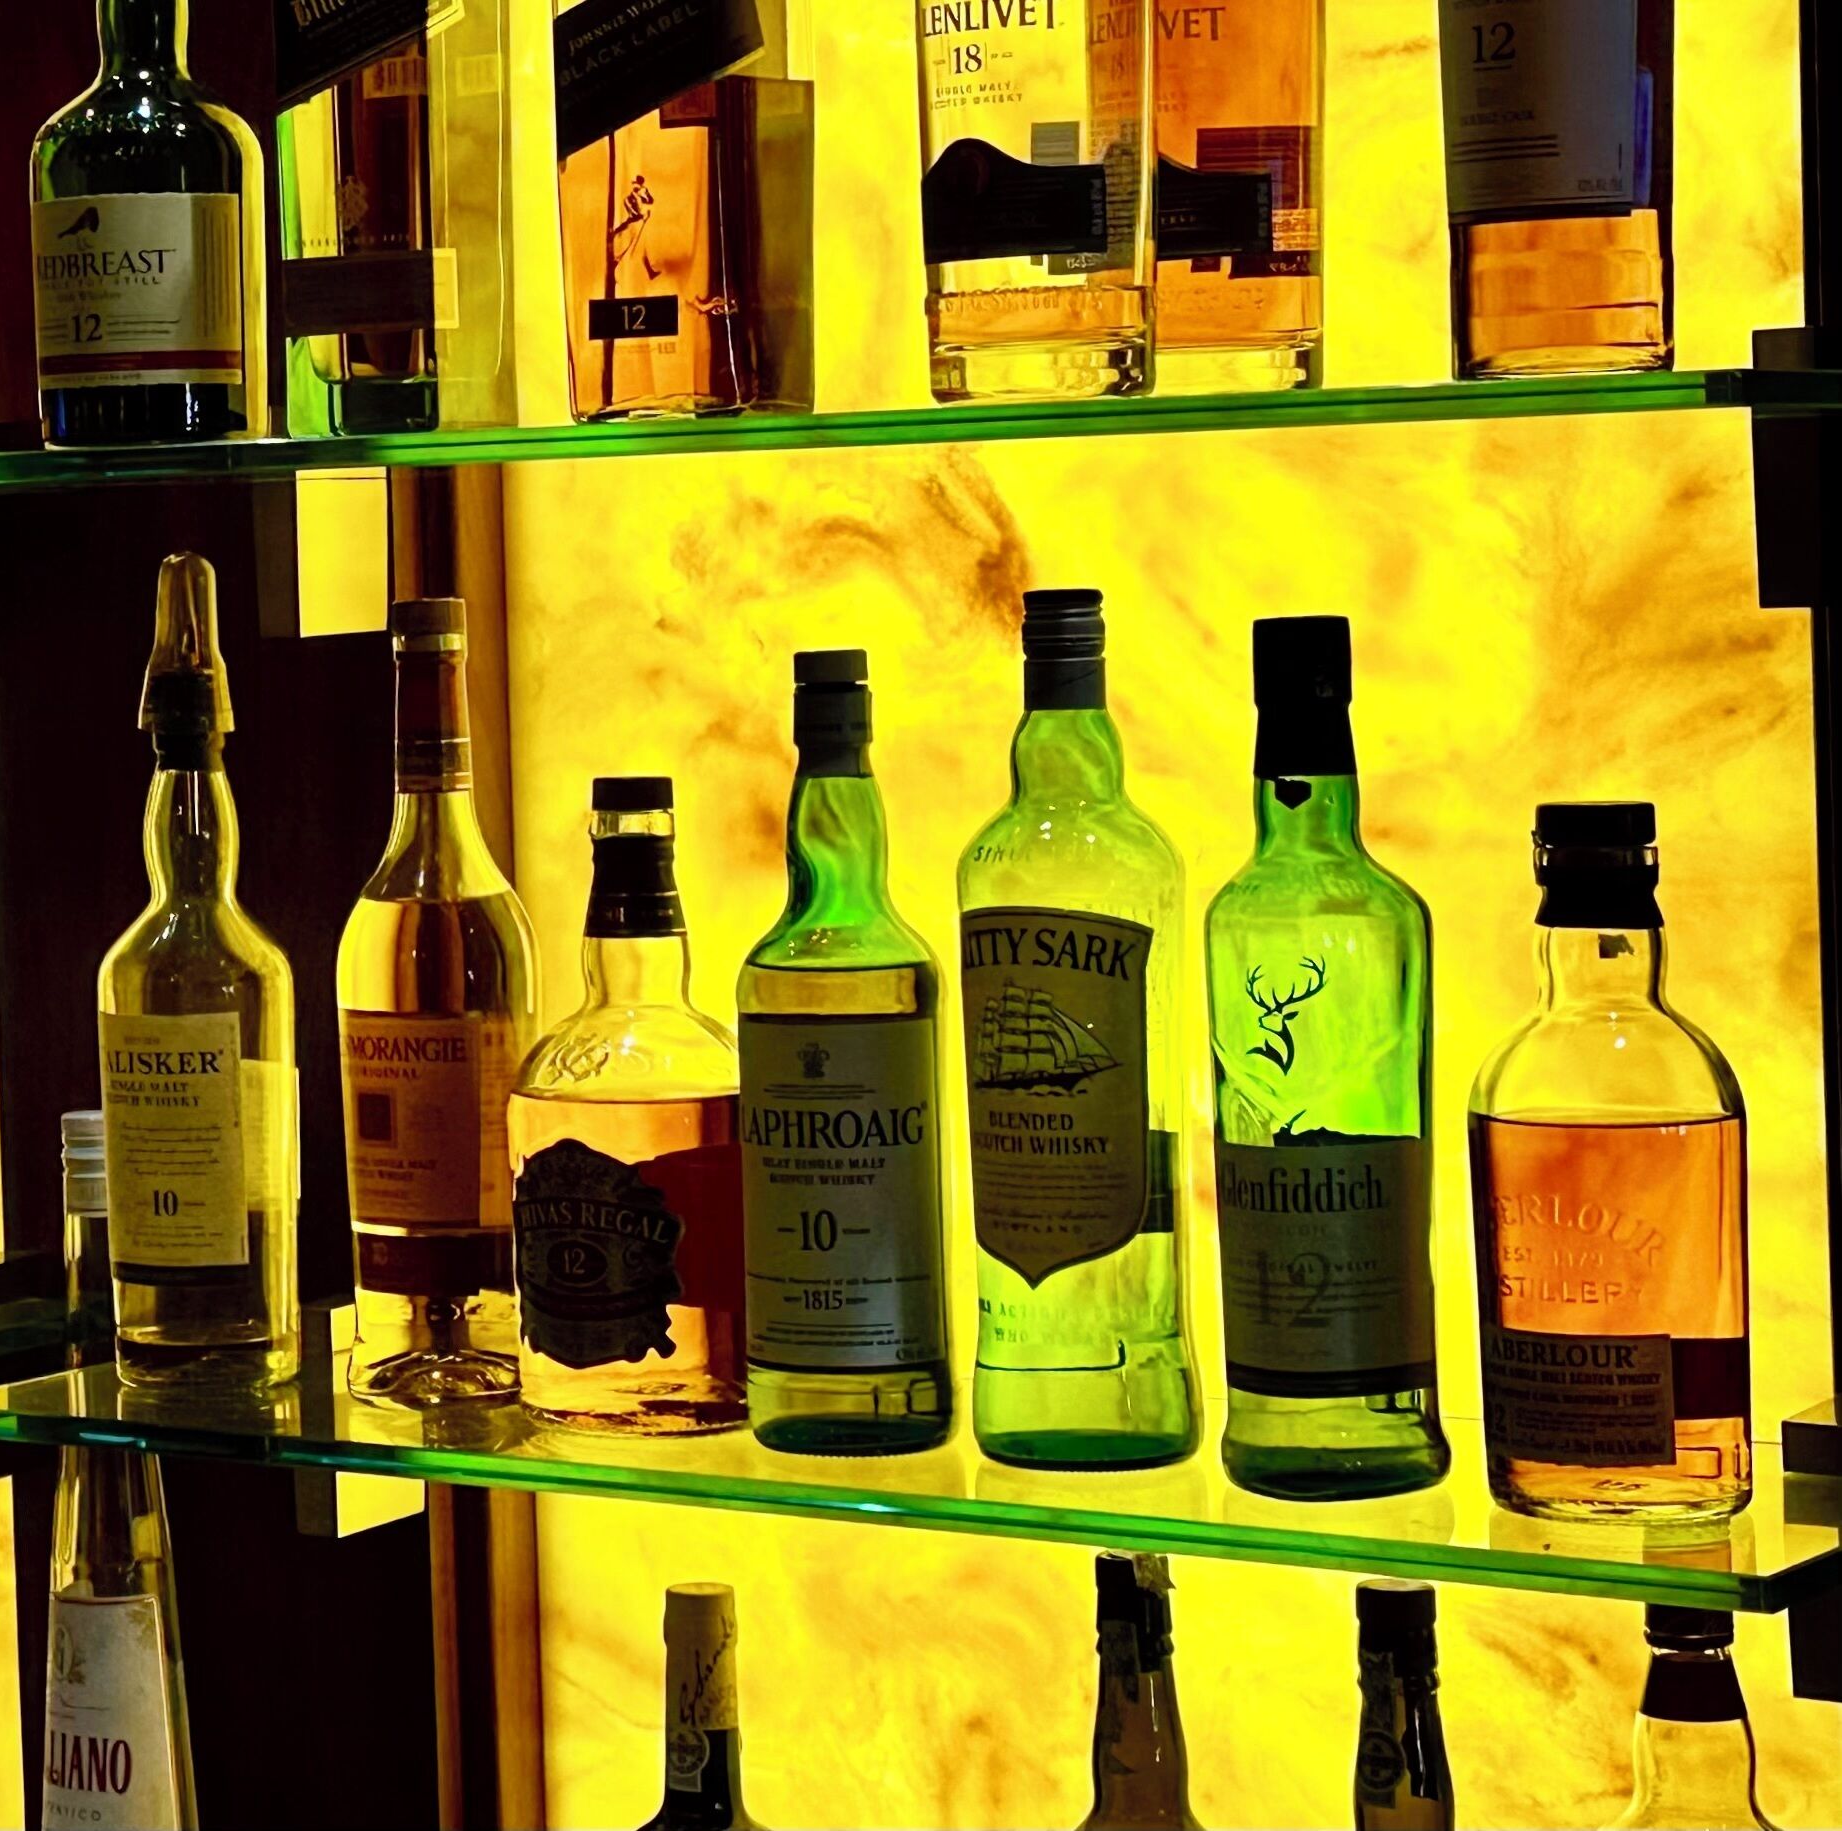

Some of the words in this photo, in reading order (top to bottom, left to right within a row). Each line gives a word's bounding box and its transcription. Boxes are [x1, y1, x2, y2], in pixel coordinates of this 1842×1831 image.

[558, 40, 627, 88] BLACK
[631, 3, 700, 47] LABEL
[1471, 21, 1516, 64] 12
[952, 43, 983, 75] 18
[37, 249, 176, 281] EDBREAST
[70, 312, 103, 343] 12
[621, 304, 647, 331] 12
[1031, 927, 1137, 981] SARK
[988, 1110, 1075, 1132] BLENDED
[1029, 1135, 1109, 1156] WHISKY
[152, 1189, 180, 1217] 10
[1220, 1161, 1391, 1215] Glenfiddich
[580, 1202, 670, 1244] REGAL
[799, 1207, 839, 1252] 10
[563, 1247, 586, 1275] 12
[803, 1288, 844, 1312] 1815
[1490, 1334, 1636, 1370] ABERLOUR
